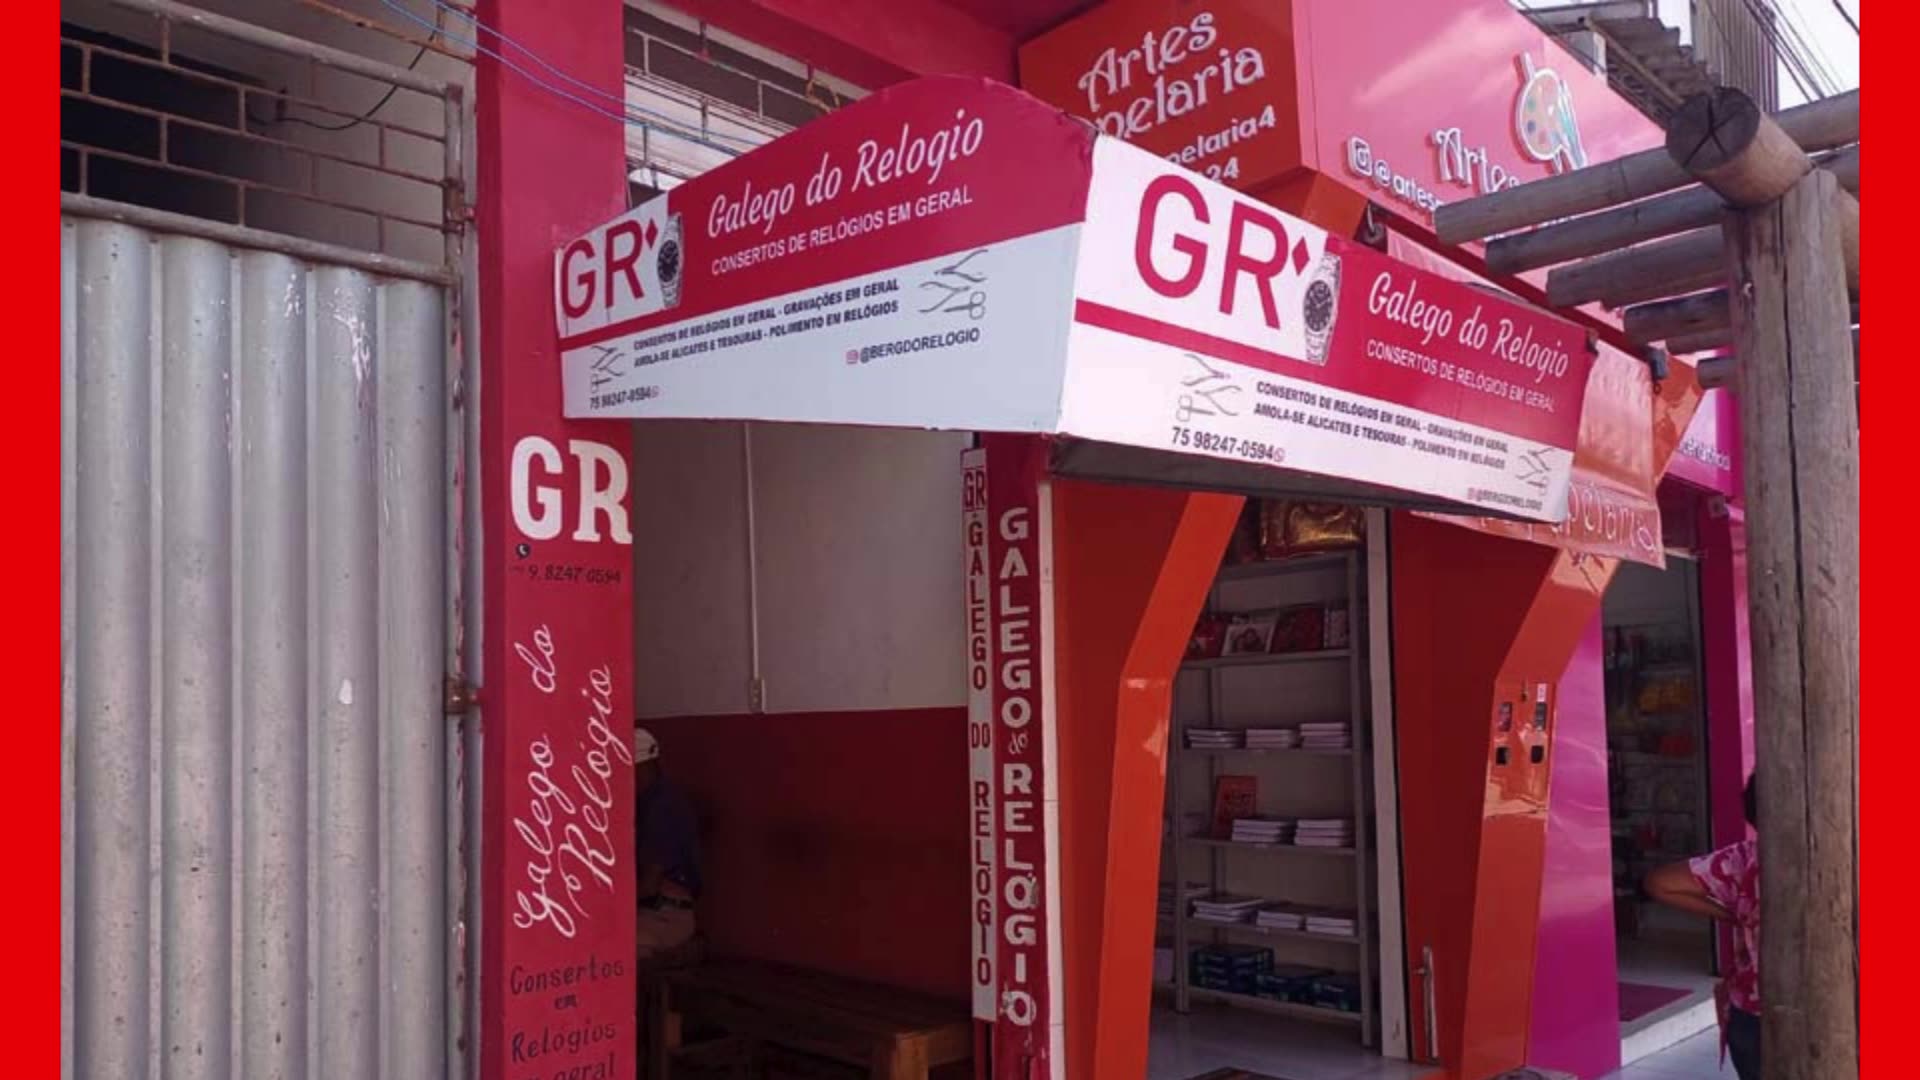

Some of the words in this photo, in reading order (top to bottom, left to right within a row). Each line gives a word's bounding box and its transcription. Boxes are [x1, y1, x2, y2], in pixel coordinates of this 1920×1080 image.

[1078, 12, 1217, 112] Artes
[708, 181, 795, 237] Galego
[806, 152, 843, 206] do
[852, 109, 984, 192] Relogio
[712, 240, 785, 276] CONSERTOS
[788, 233, 807, 253] DE
[810, 210, 884, 248] RELÓGIOS
[888, 202, 911, 226] EM
[915, 185, 973, 217] GERAL
[1135, 173, 1289, 330] GR
[561, 220, 646, 319] GR
[634, 332, 677, 350] CONSERTOS
[679, 327, 689, 340] DE
[732, 314, 746, 328] EM
[747, 308, 776, 324] GERAL
[845, 286, 861, 300] EM
[863, 278, 900, 297] GERAL
[717, 329, 762, 349] TESOURAS
[769, 317, 825, 338] POLIMENTO
[860, 327, 981, 364] @BERGDORELOGIO
[1368, 271, 1453, 345] Galego
[1459, 305, 1489, 350] do
[1491, 319, 1569, 384] Relogio
[1257, 381, 1317, 406] CONSERTOS
[1319, 396, 1332, 411] DE
[1380, 411, 1393, 423] EM
[1395, 415, 1421, 431] GERAL
[1367, 339, 1438, 376] CONSERTOS
[1439, 361, 1454, 381] DE
[1509, 385, 1524, 401] EM
[1525, 389, 1555, 413] GERAL
[1172, 426, 1190, 446] 75
[1193, 431, 1274, 460] 98247-0594
[1254, 403, 1306, 424] AMOLA-SE
[1307, 414, 1352, 435] ALICATES
[1353, 425, 1360, 437] E
[1362, 427, 1407, 447] TESOURAS
[510, 436, 633, 544] GR
[964, 470, 985, 508] GR
[969, 521, 988, 690] GALEGO
[1000, 507, 1032, 728] GALEGO
[514, 624, 557, 693] do
[971, 722, 991, 748] DO
[513, 735, 576, 938] Galego
[510, 952, 625, 996] Consertos
[554, 993, 577, 1010] em
